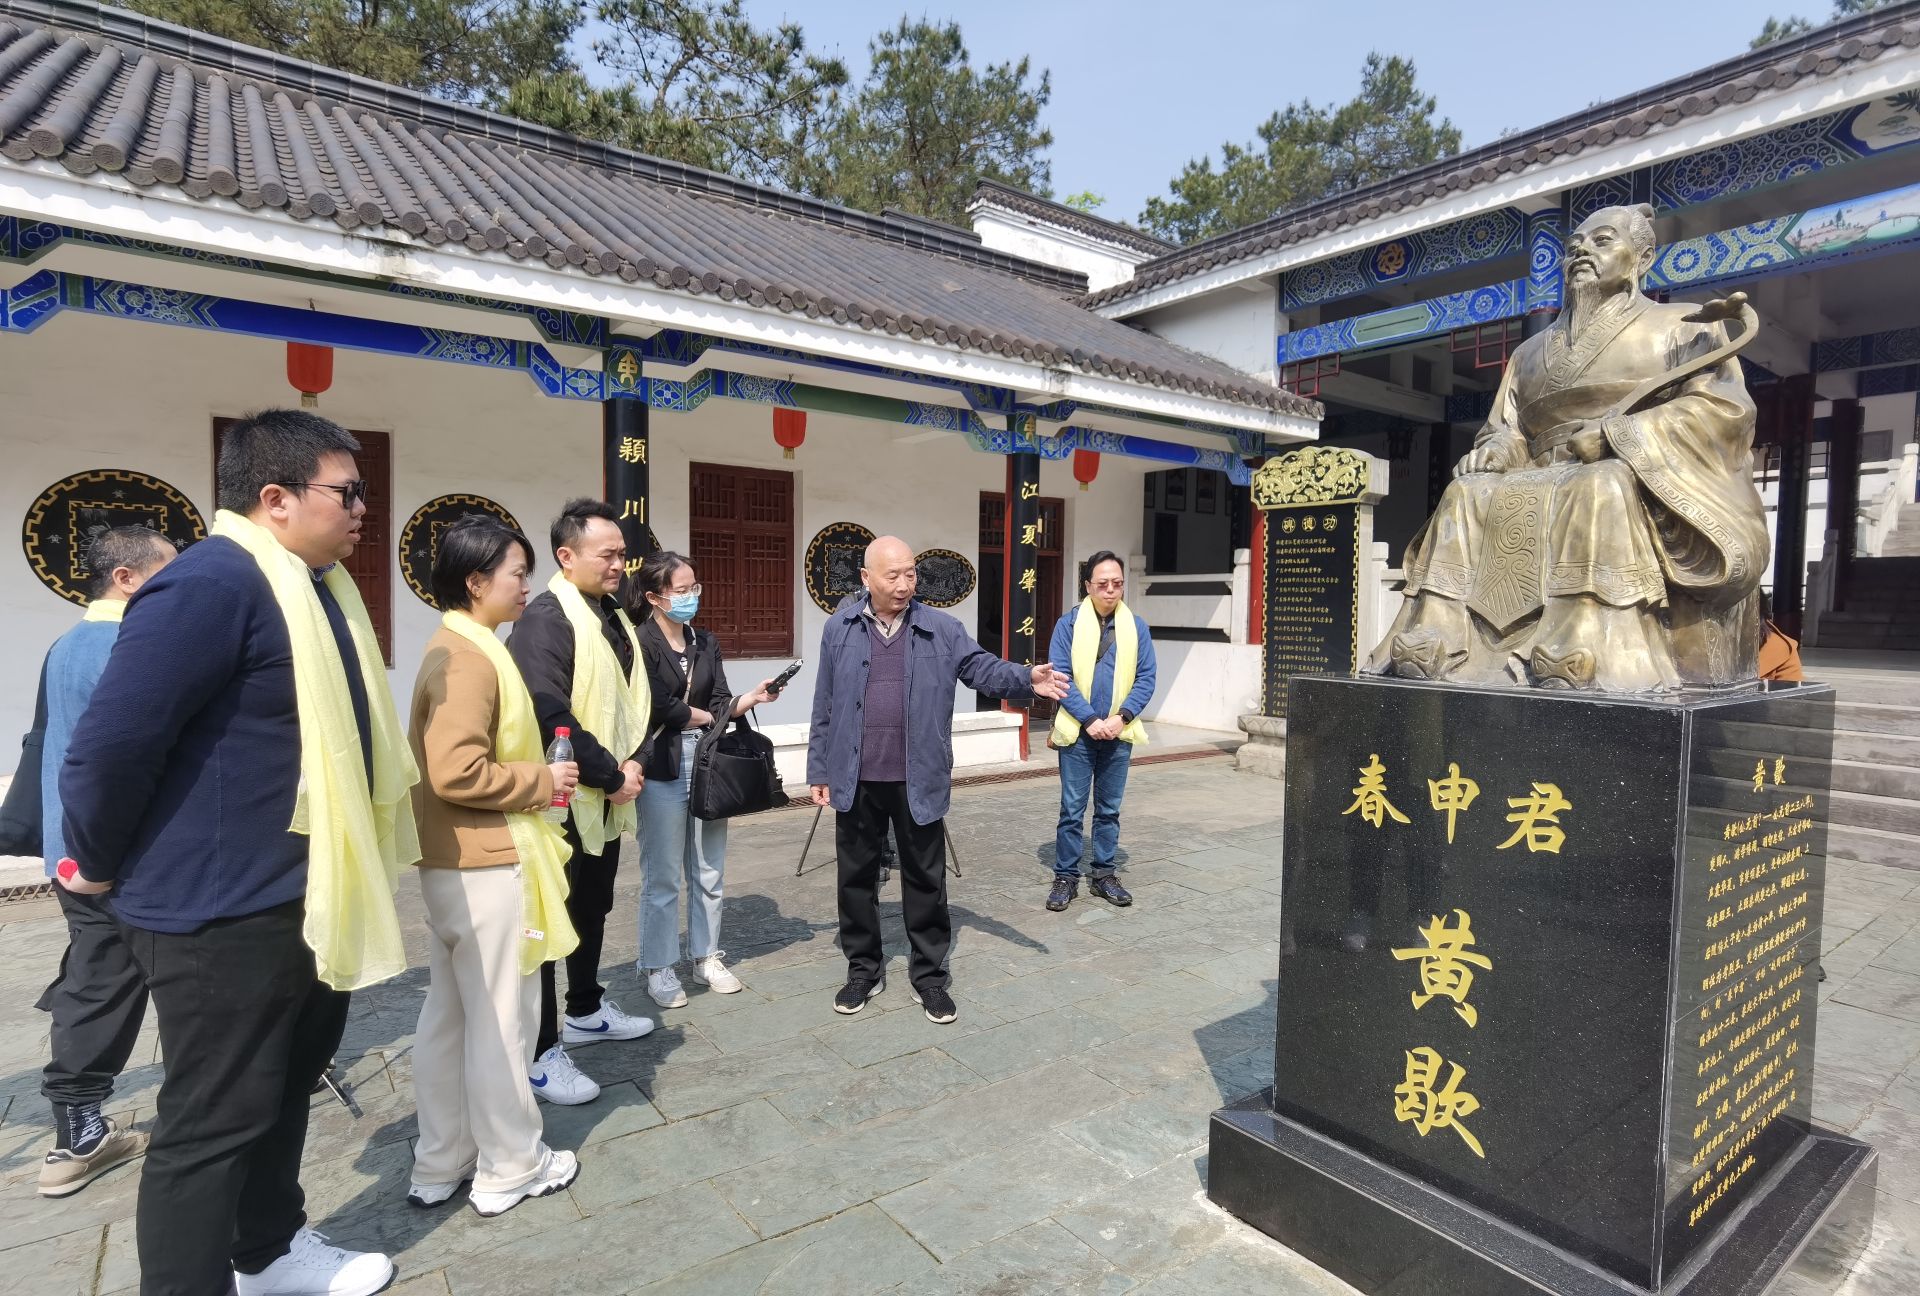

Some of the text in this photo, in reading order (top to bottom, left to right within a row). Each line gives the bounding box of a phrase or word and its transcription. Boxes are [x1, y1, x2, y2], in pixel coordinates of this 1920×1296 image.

[1015, 481, 1039, 667] 江夏肇名
[1342, 753, 1573, 854] 春申君
[1752, 755, 1787, 793] 黄歇
[1391, 908, 1493, 1158] 黄歇
